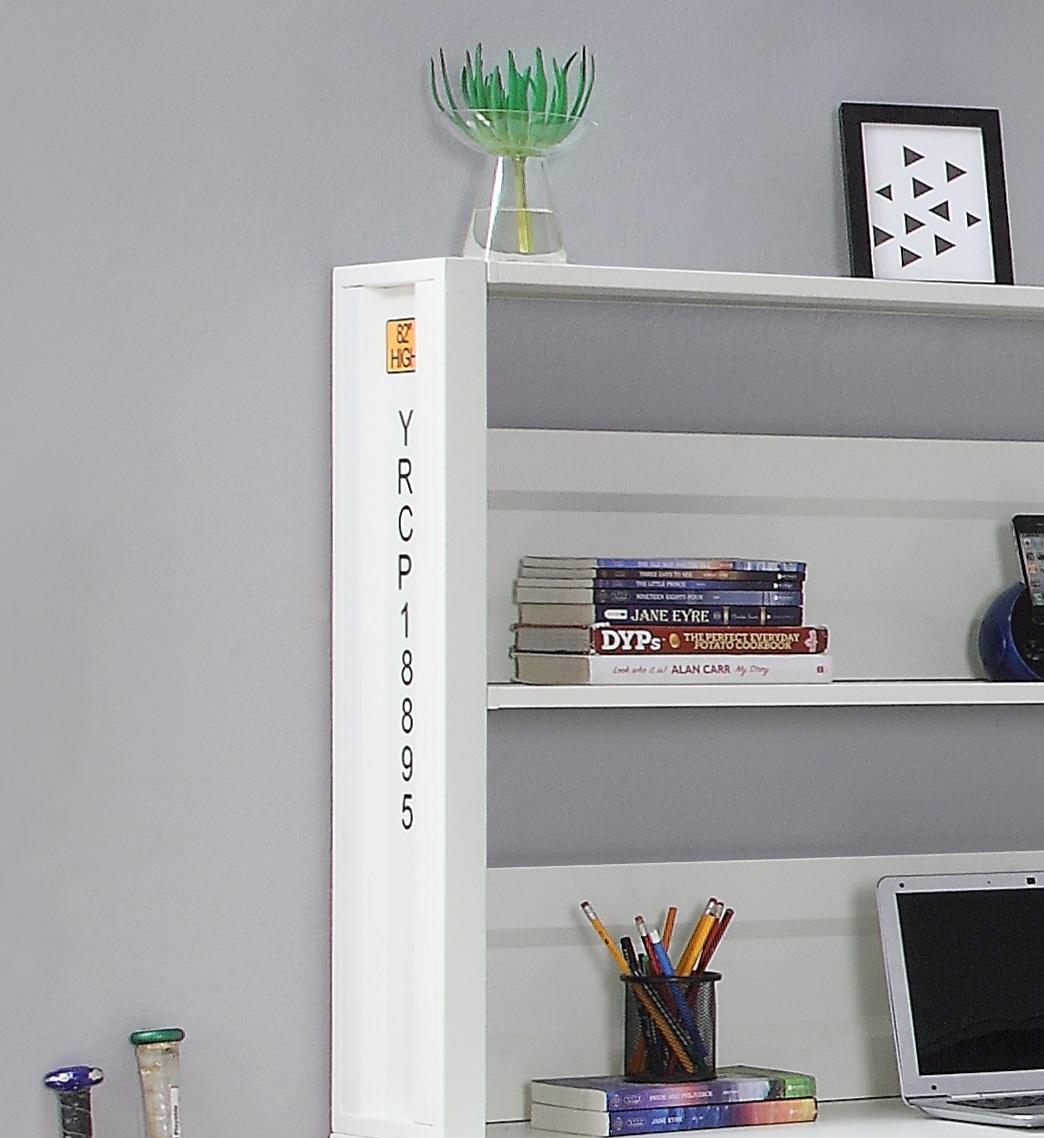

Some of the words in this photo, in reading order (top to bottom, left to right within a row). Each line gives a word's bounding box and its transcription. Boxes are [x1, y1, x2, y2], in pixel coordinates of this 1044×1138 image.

[630, 608, 669, 622] JANE
[672, 608, 709, 623] EYRE
[600, 629, 661, 651] DYPs
[682, 632, 705, 642] THE
[705, 632, 748, 642] PERFECT
[750, 632, 800, 643] EVERYDAY
[693, 641, 734, 650] POTATO
[735, 641, 792, 650] COOKBOOK
[671, 664, 700, 675] ALAN
[702, 664, 731, 675] CARR
[735, 665, 747, 677] My
